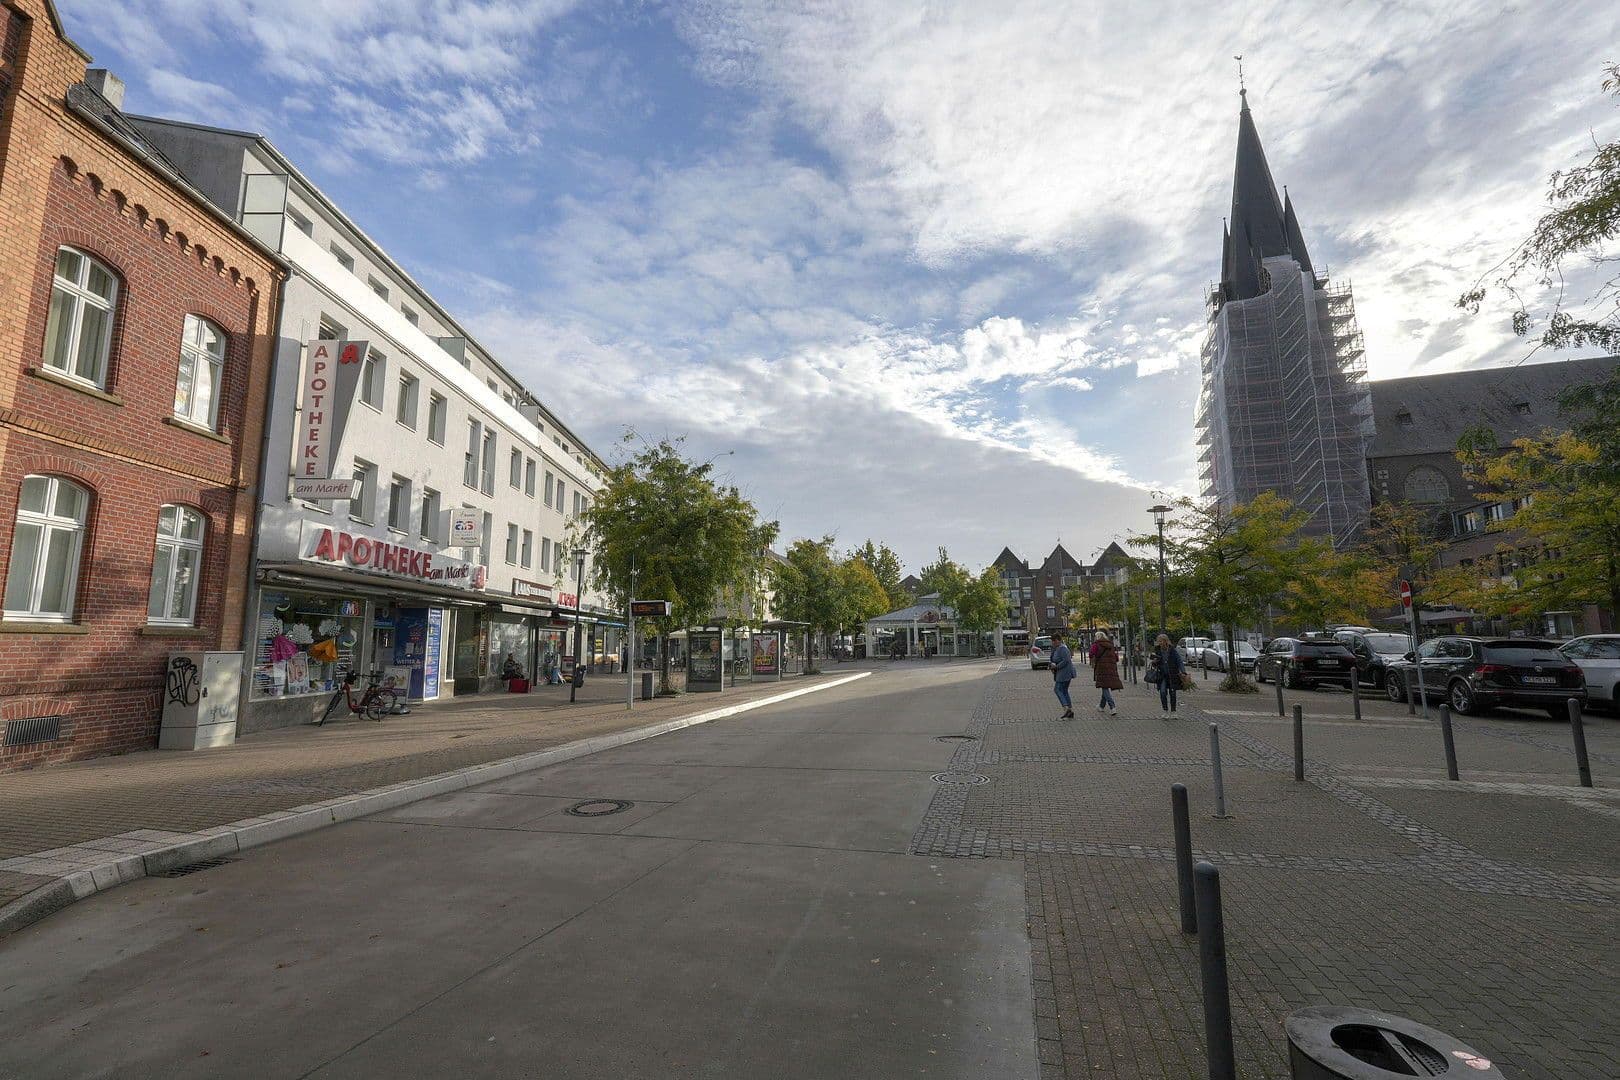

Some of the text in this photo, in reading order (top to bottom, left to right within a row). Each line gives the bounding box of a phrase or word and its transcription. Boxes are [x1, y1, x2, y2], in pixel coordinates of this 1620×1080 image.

[304, 345, 329, 476] APOTHEKE
[296, 484, 348, 494] am Markt
[315, 529, 469, 580] APOTHEKE am Markt
